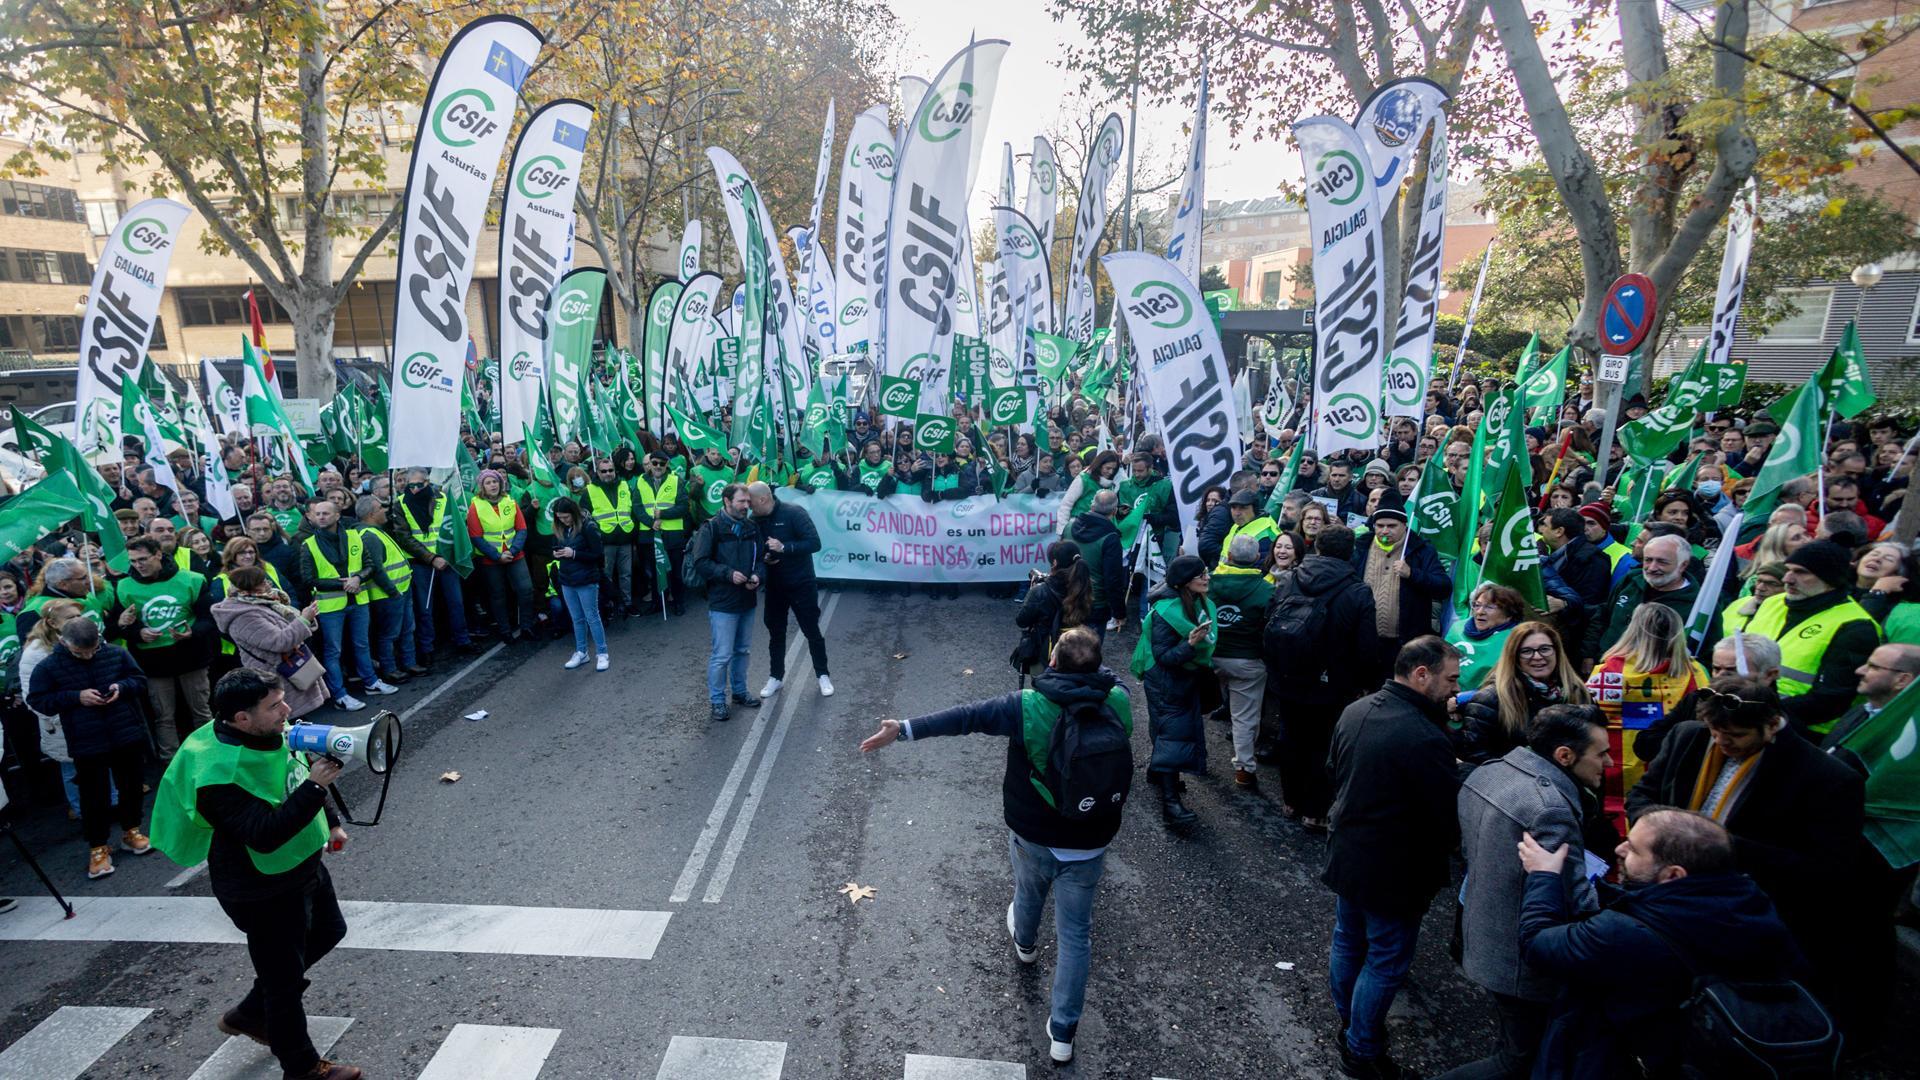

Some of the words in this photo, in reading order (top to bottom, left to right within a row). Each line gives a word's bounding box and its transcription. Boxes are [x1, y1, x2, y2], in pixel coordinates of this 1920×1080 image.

[446, 103, 497, 138] CSIF
[933, 102, 982, 124] CSIF
[441, 150, 487, 181] Asturias
[527, 167, 570, 190] CSIF
[527, 202, 565, 219] Asturias
[133, 226, 170, 251] CSIF
[409, 163, 469, 342] CSIF
[900, 182, 957, 336] CSIF
[114, 256, 155, 285] GALICIA
[509, 213, 558, 341] CSIF
[562, 300, 592, 315] CSIF
[88, 270, 149, 396] CSIF
[408, 361, 443, 380] CSIF
[514, 360, 533, 371] CSIF
[1605, 359, 1622, 369] GIRO
[969, 347, 986, 408] CSIF
[1604, 369, 1620, 379] BUS
[429, 384, 453, 393] Asturias
[888, 391, 915, 404] CSIF
[998, 399, 1022, 412] CSIF
[923, 425, 951, 440] CSIF
[836, 500, 877, 518] CSIF
[955, 504, 975, 513] CSIF
[846, 520, 861, 531] La
[867, 511, 937, 537] SANIDAD
[947, 528, 962, 537] es
[967, 528, 986, 537] un
[990, 512, 1057, 536] DERECH
[823, 553, 844, 562] CSIF
[848, 552, 870, 563] por
[875, 551, 887, 562] la
[891, 543, 968, 566] DEFENSA
[977, 554, 996, 566] de
[149, 605, 182, 619] CSIF
[1217, 611, 1243, 623] CSIF
[337, 739, 352, 749] CSIF
